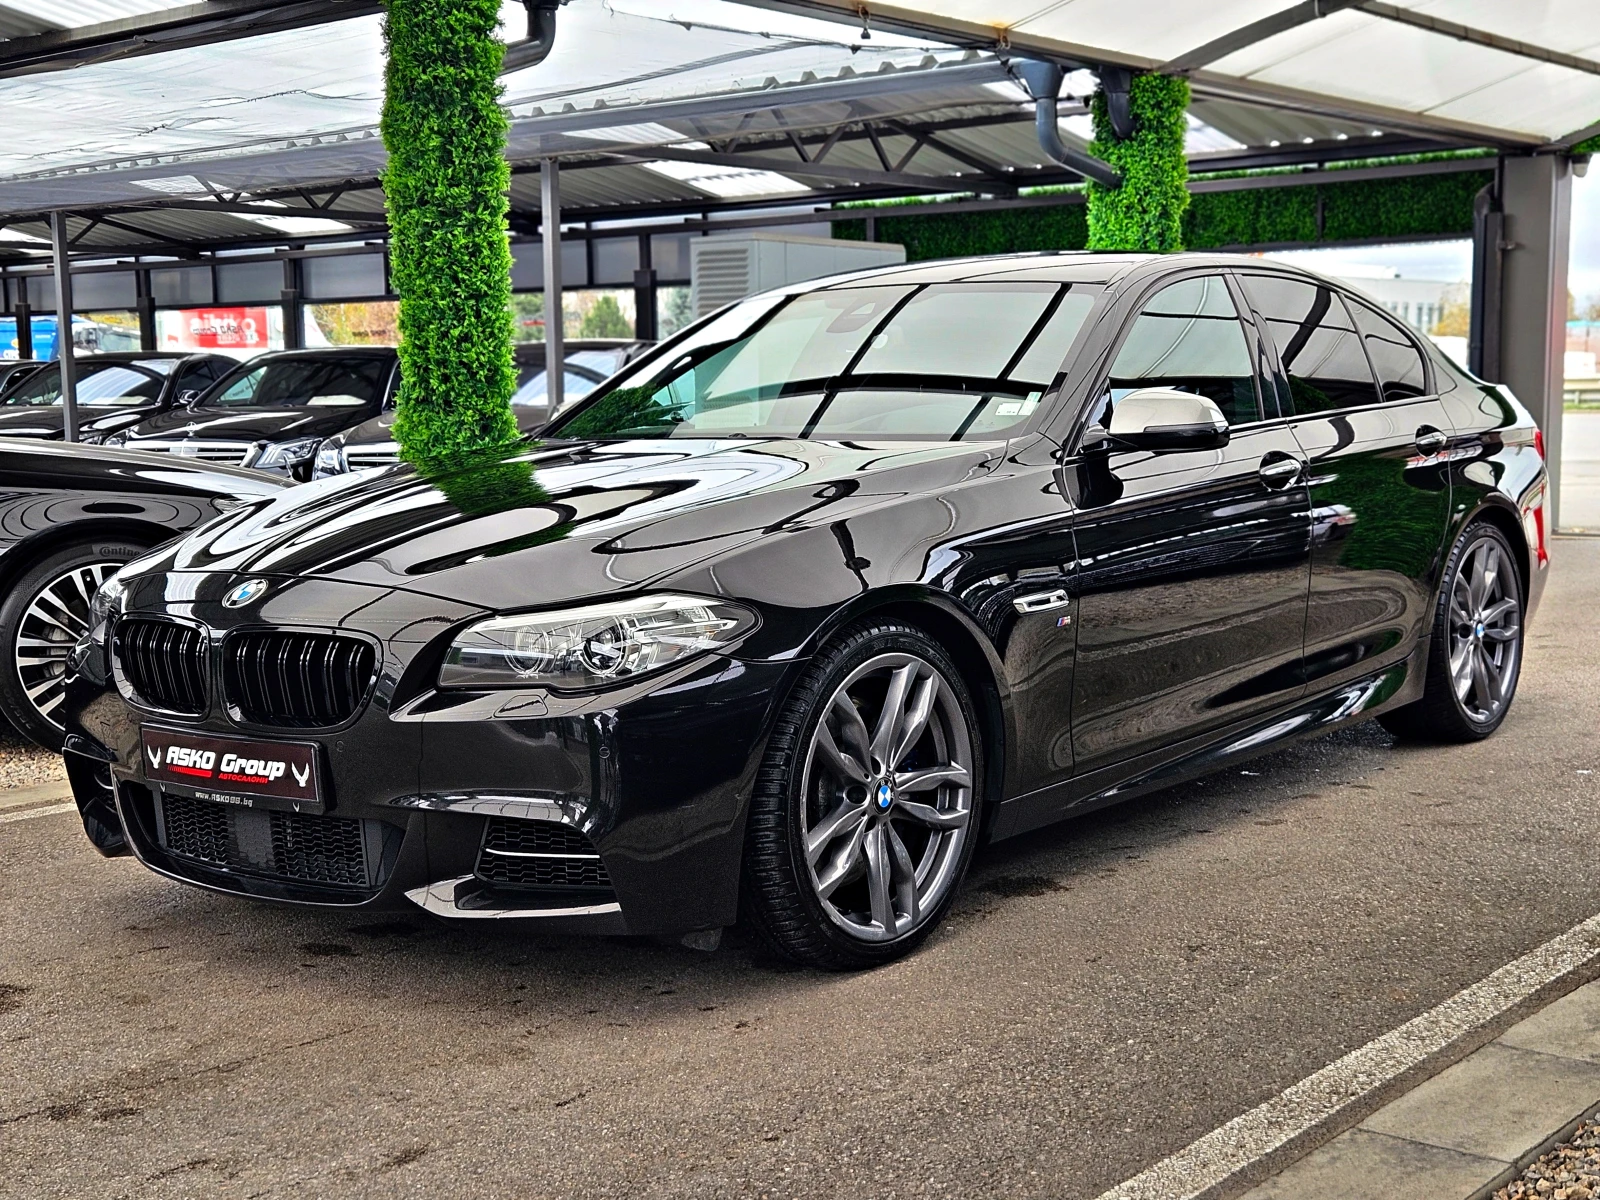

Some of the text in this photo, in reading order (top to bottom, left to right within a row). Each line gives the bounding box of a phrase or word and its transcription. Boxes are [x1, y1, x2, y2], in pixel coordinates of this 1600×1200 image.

[99, 546, 141, 558] Contine
[165, 745, 286, 781] ASKO Group
[218, 773, 269, 784] АВТОСАЛОНИ
